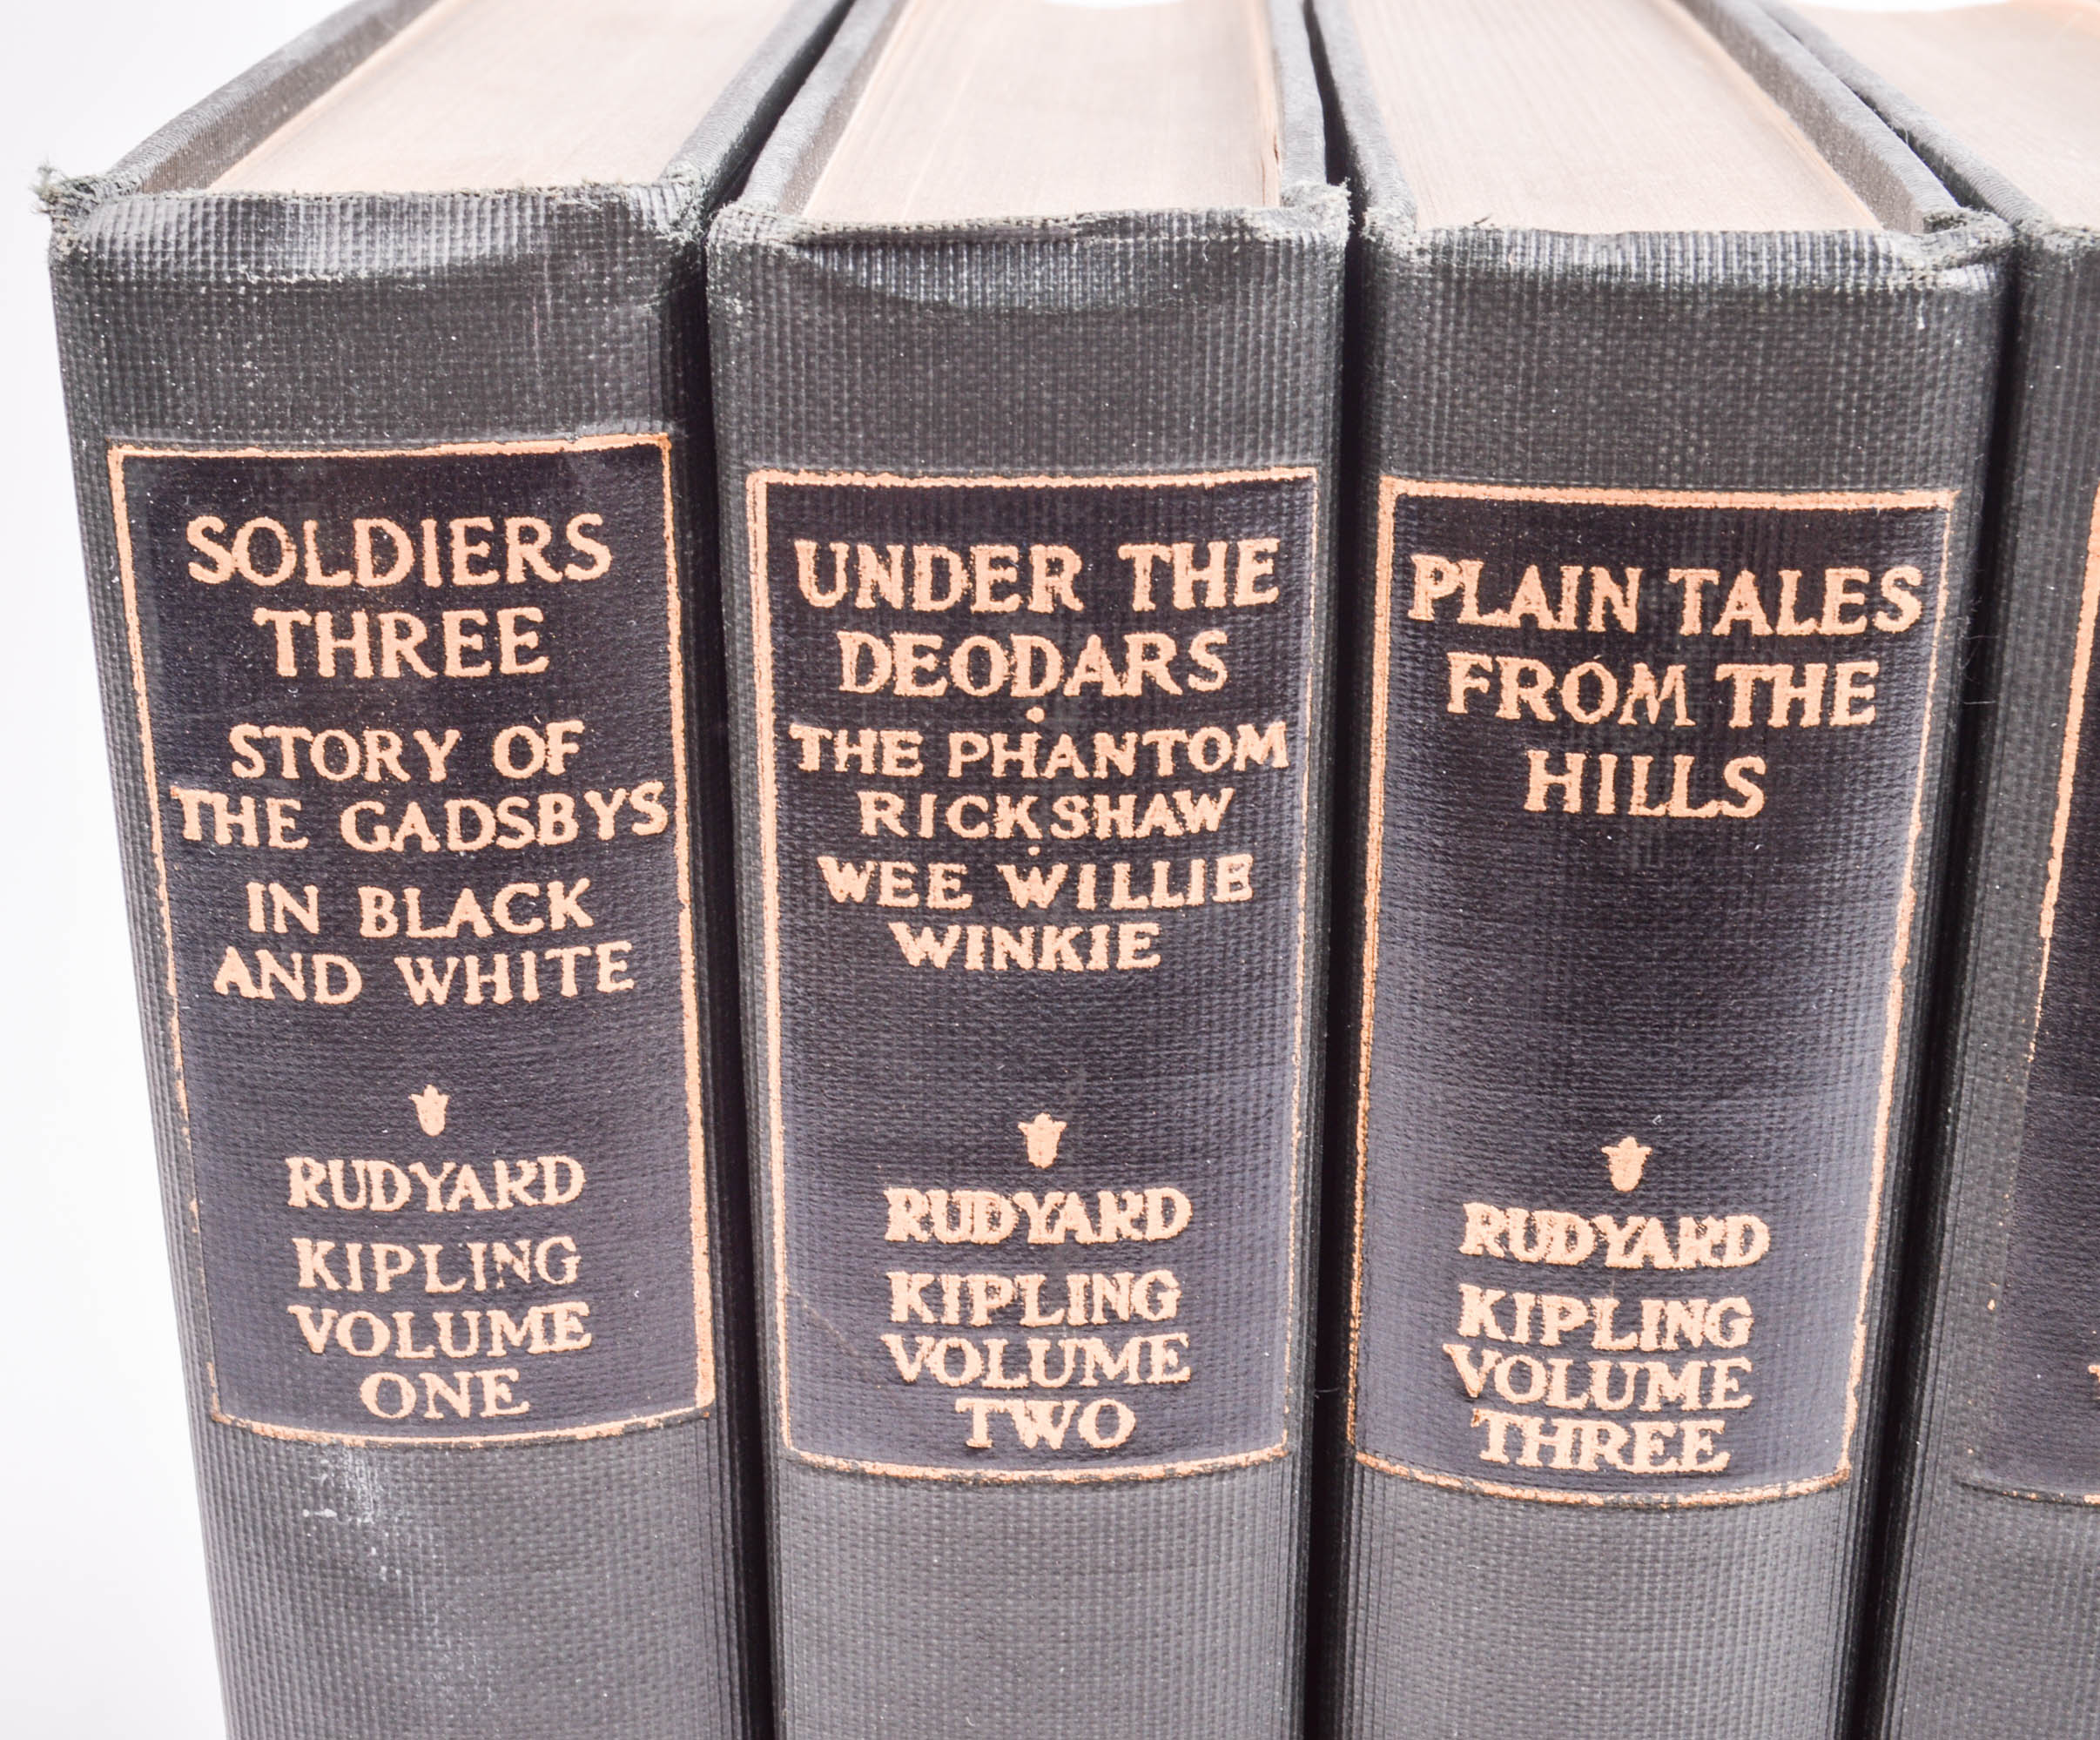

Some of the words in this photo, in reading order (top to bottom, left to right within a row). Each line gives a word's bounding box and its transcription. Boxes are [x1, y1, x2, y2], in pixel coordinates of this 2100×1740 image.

[186, 513, 613, 588] SOLDIERS
[794, 539, 1085, 614] UNDER
[1118, 536, 1281, 612] THE
[1408, 552, 1643, 634] PLAIN
[1668, 564, 1926, 636] TALES
[252, 607, 549, 679] THREE
[836, 628, 1228, 698] DEODARS
[1447, 651, 1695, 726] FROM
[1715, 659, 1880, 729] THE
[229, 722, 461, 783] STORY
[491, 718, 585, 779] OF
[788, 722, 925, 777] THE
[947, 720, 1290, 779] PHANTOM
[170, 785, 309, 850] THE
[339, 780, 669, 852] GADSBYS
[857, 787, 1235, 841] RICKSHAW
[1524, 749, 1767, 818] HILLS
[246, 881, 320, 934] IN
[358, 877, 595, 939] BLACK
[817, 855, 973, 910] WEE
[213, 946, 362, 1004] AND
[394, 940, 637, 1006] WHITE
[887, 921, 1161, 971] WINKIE
[286, 1154, 587, 1214] RUDYARD
[882, 1186, 1194, 1245] RUDYARD
[291, 1235, 582, 1293] KIPLING
[1459, 1201, 1771, 1270] RUDYARD
[286, 1300, 594, 1360] VOLUME
[886, 1268, 1182, 1327] KIPLING
[1456, 1284, 1755, 1352] KIPLING
[360, 1367, 531, 1420] ONE
[880, 1333, 1193, 1391] VOLUME
[1442, 1344, 1755, 1413] VOLUME
[954, 1398, 1138, 1450] TWO
[1471, 1407, 1732, 1475] THREE
